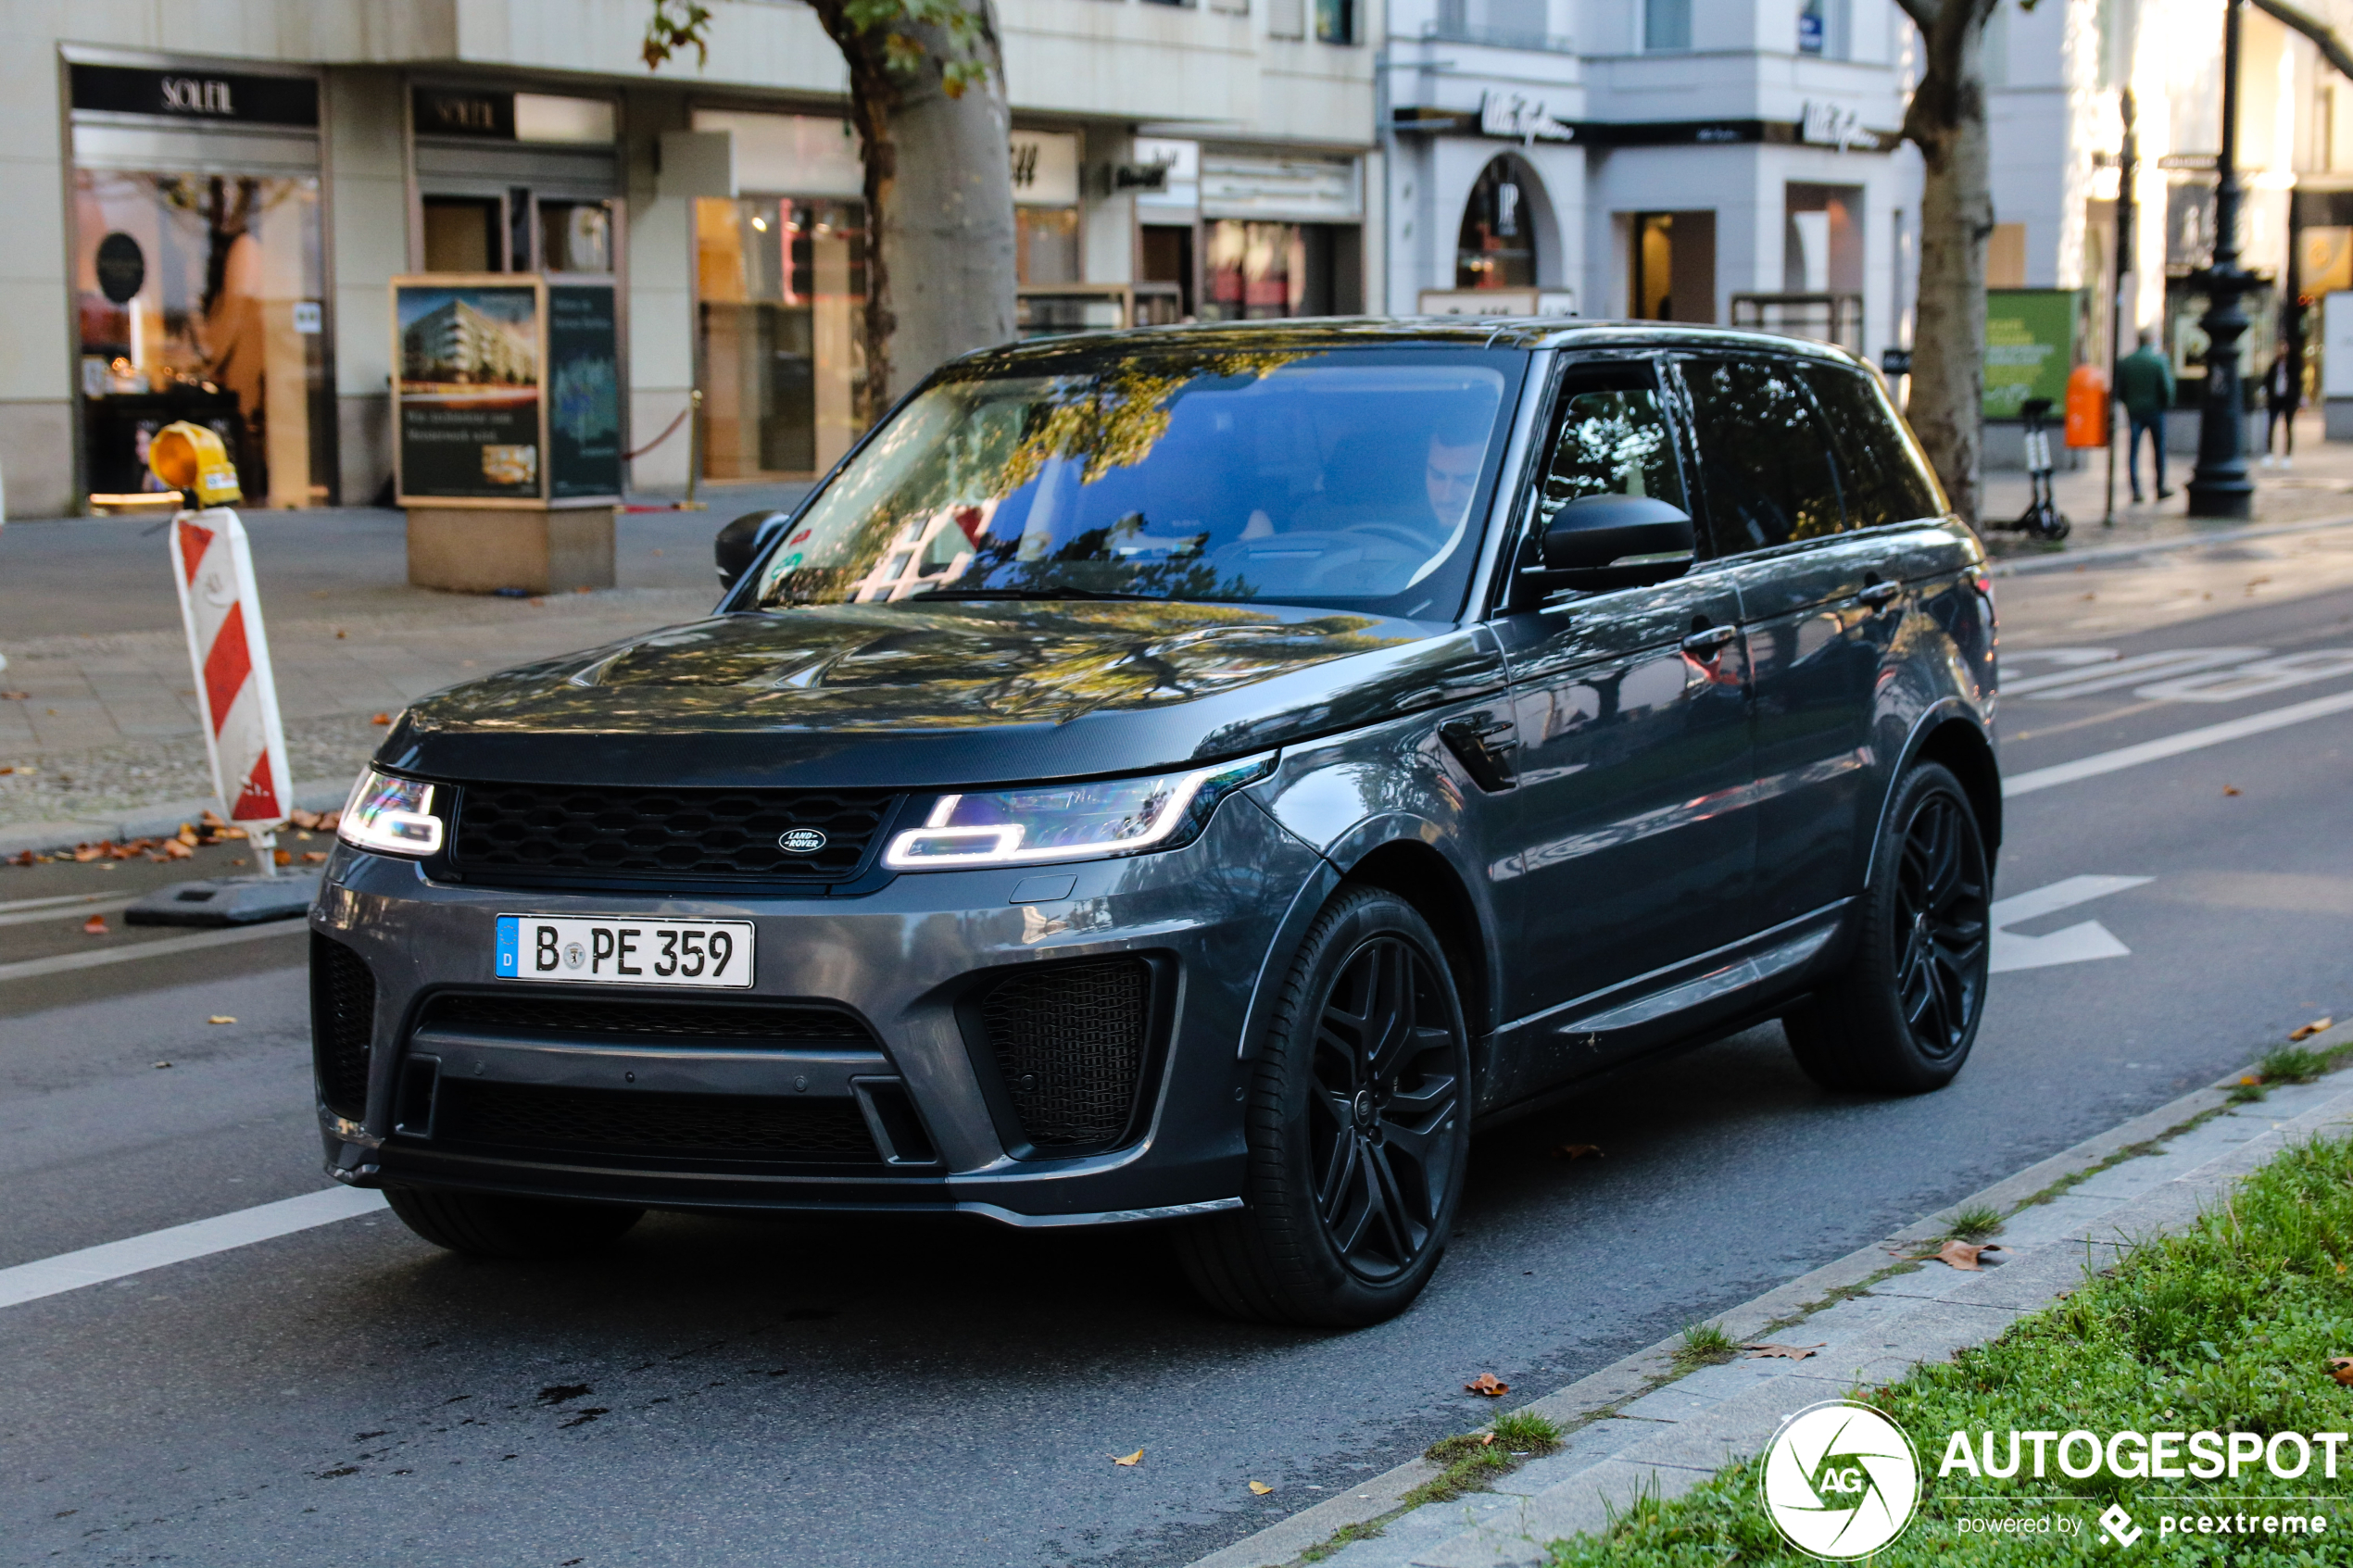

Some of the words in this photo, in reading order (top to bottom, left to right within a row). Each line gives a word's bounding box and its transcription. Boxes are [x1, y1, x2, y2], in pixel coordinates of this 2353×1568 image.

[503, 953, 512, 967] D
[536, 925, 560, 971] B
[591, 928, 643, 975] PE
[654, 930, 733, 977] 359
